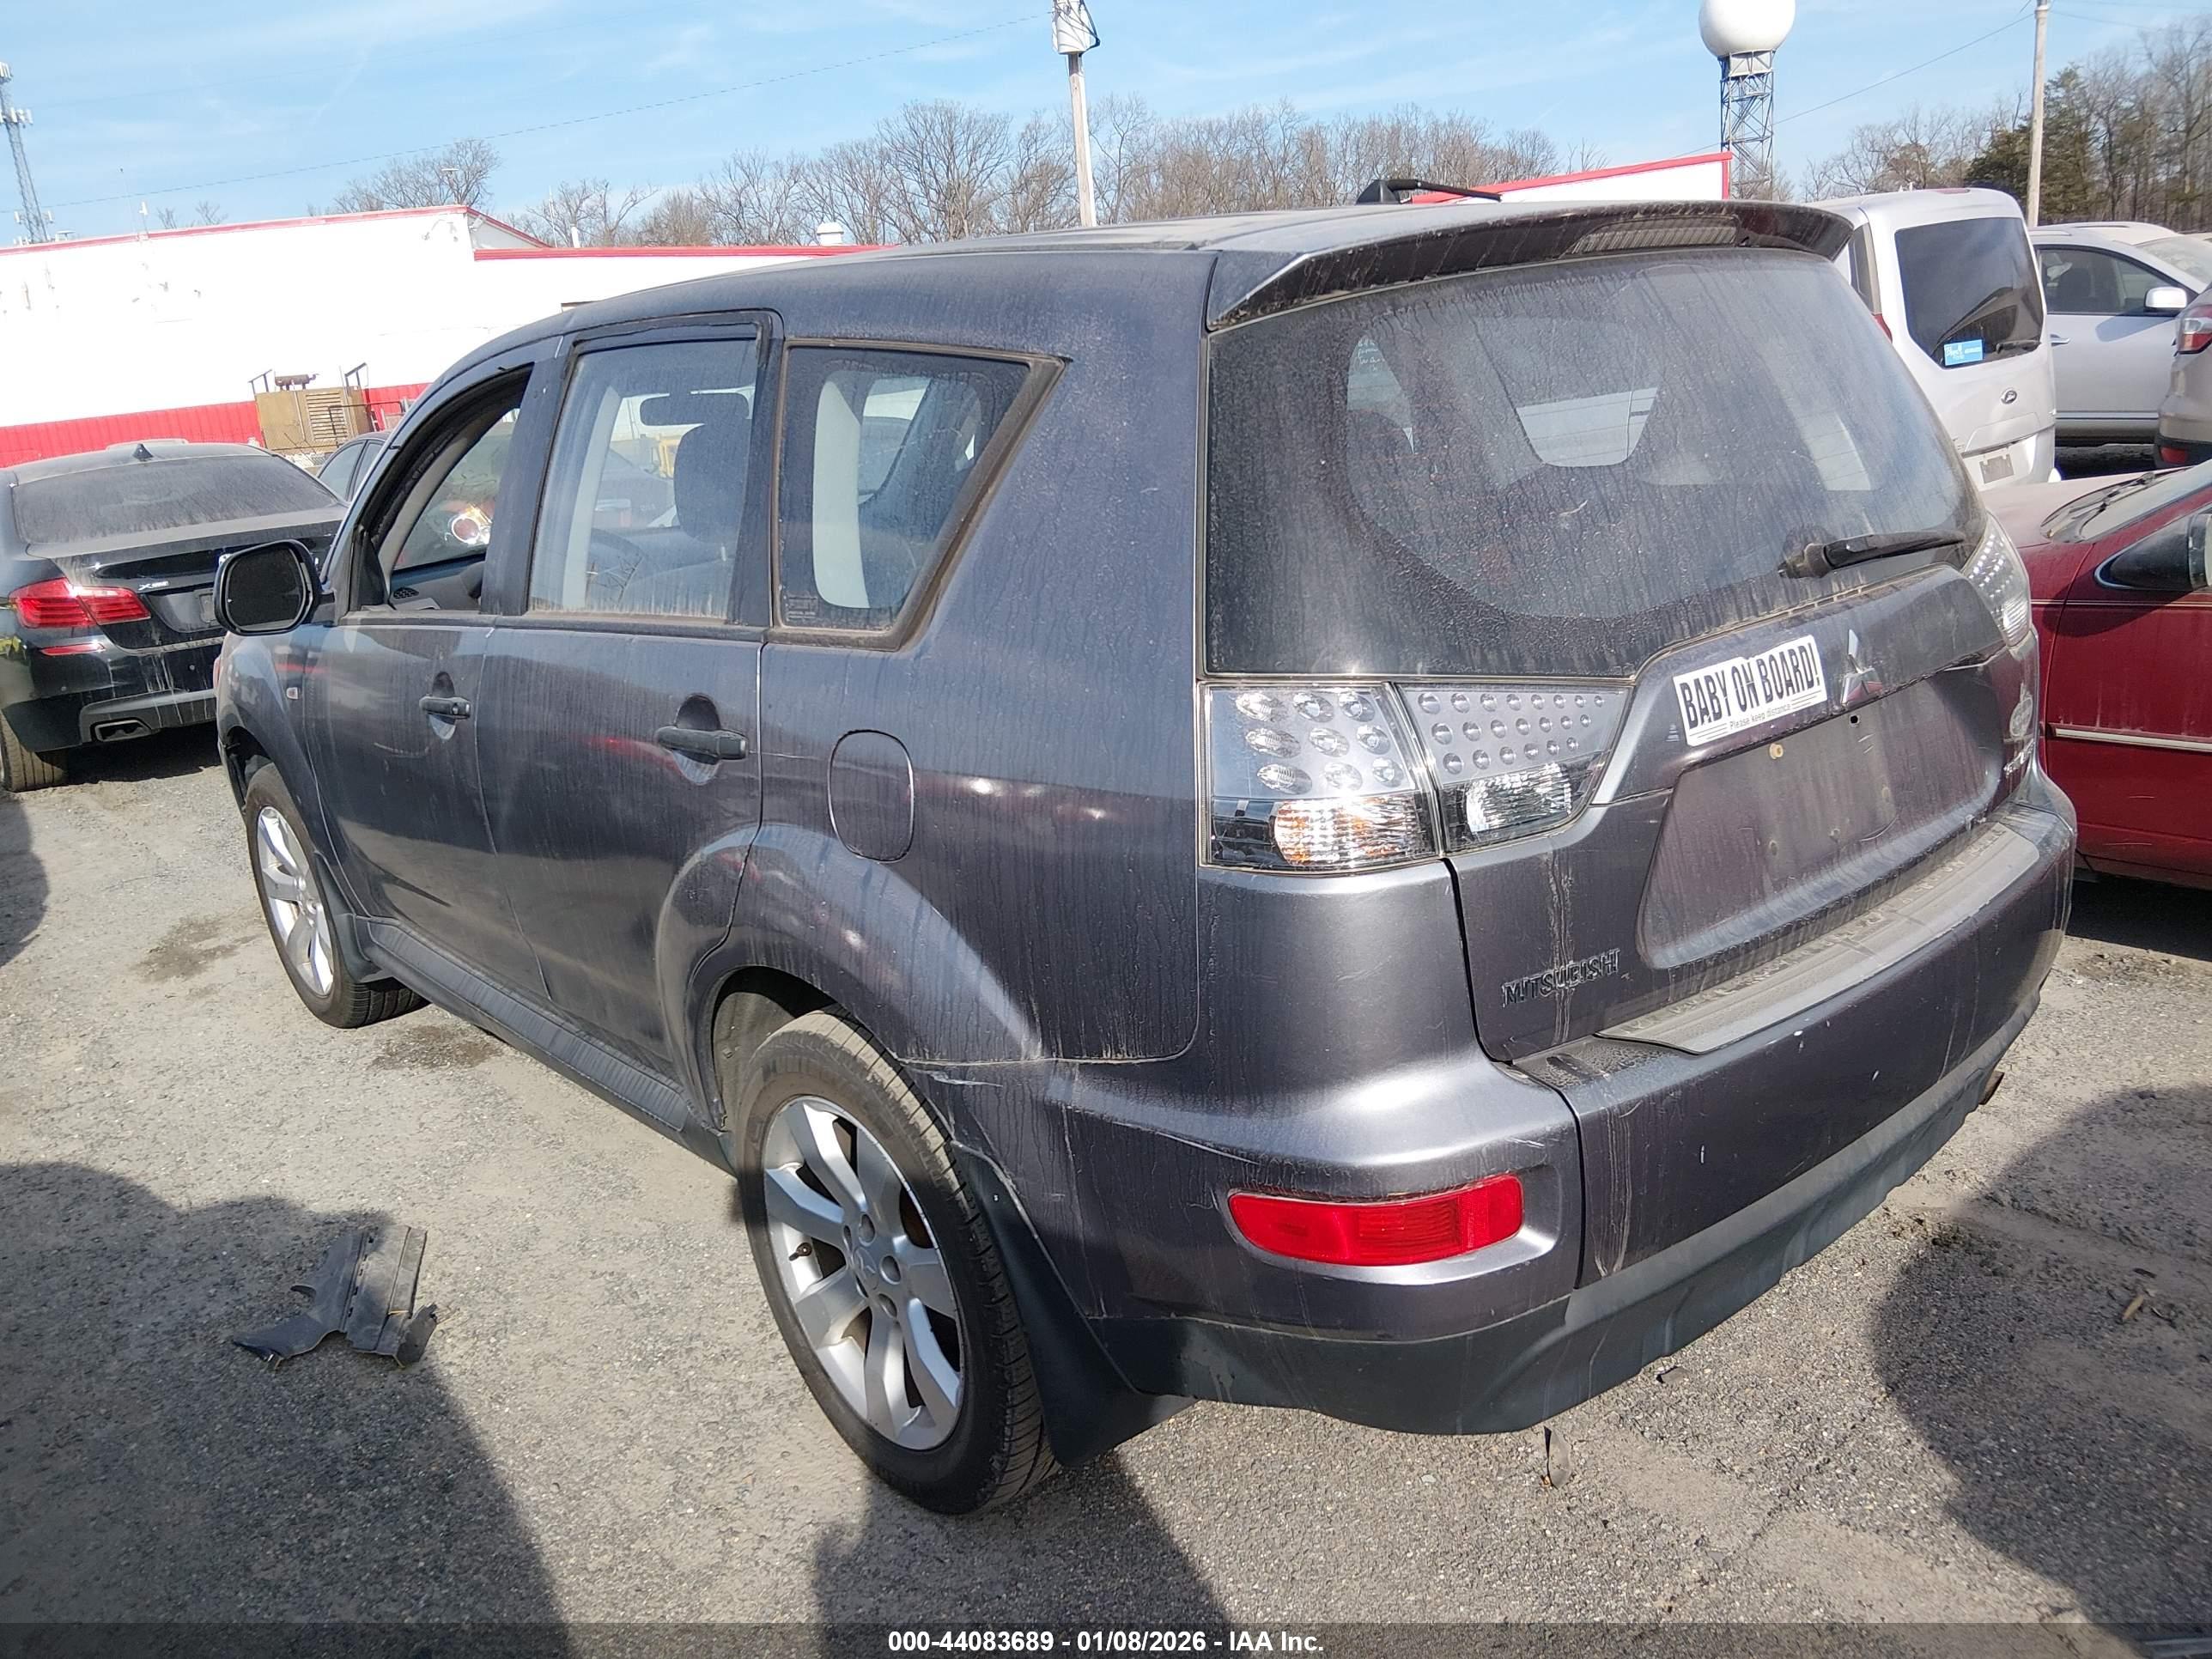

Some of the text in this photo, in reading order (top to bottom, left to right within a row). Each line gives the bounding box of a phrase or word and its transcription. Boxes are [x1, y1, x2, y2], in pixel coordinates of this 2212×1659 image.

[1679, 642, 1820, 729] BABY ON BOARD!
[1729, 702, 1792, 730] Please keep distance
[1502, 948, 1620, 1007] MITSUBISHI
